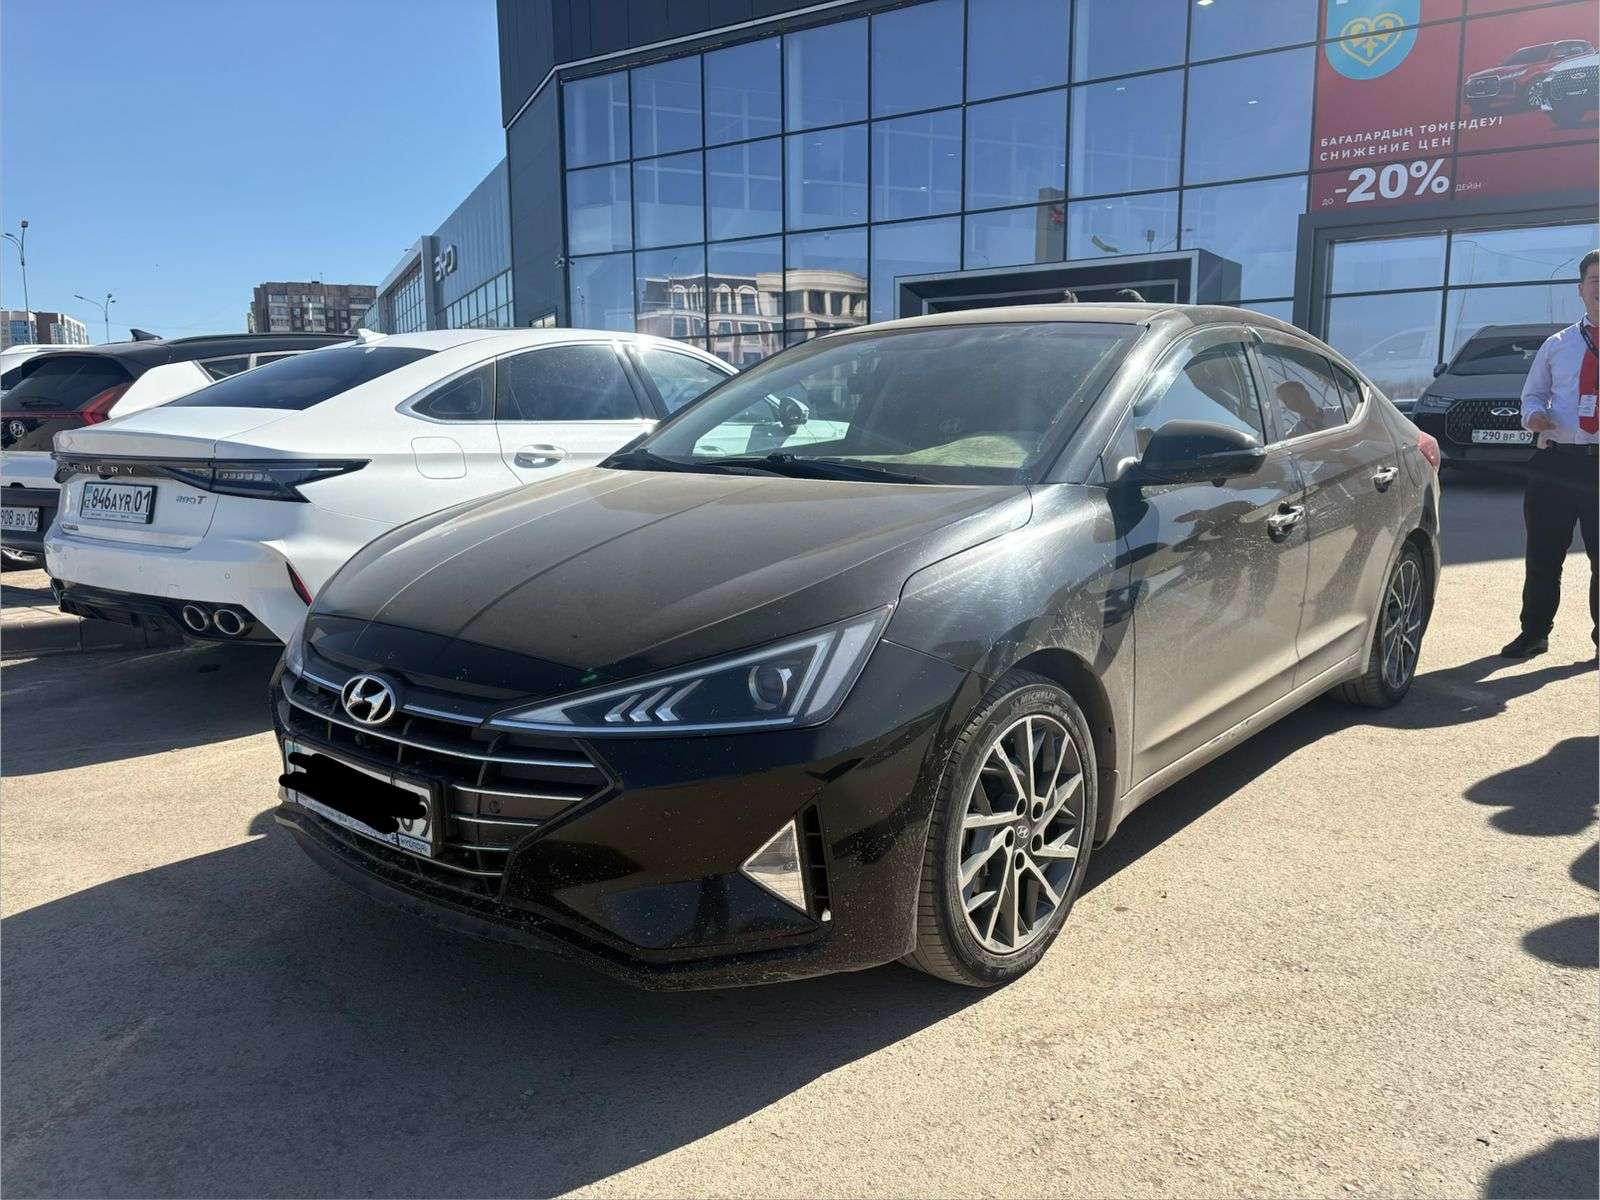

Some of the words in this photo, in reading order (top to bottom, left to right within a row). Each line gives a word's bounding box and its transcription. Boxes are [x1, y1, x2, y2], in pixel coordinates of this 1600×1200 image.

[1320, 127, 1414, 147] БАҒАЛАРДЫҢ
[1419, 116, 1503, 134] ТӨМЕНДЕУІ
[1319, 141, 1410, 161] СНИЖЕНИЕ
[1418, 136, 1452, 150] ЦЕН
[1334, 158, 1450, 203] -20%
[1482, 431, 1501, 441] 290
[1519, 431, 1532, 441] 09
[73, 464, 134, 475] CHERY
